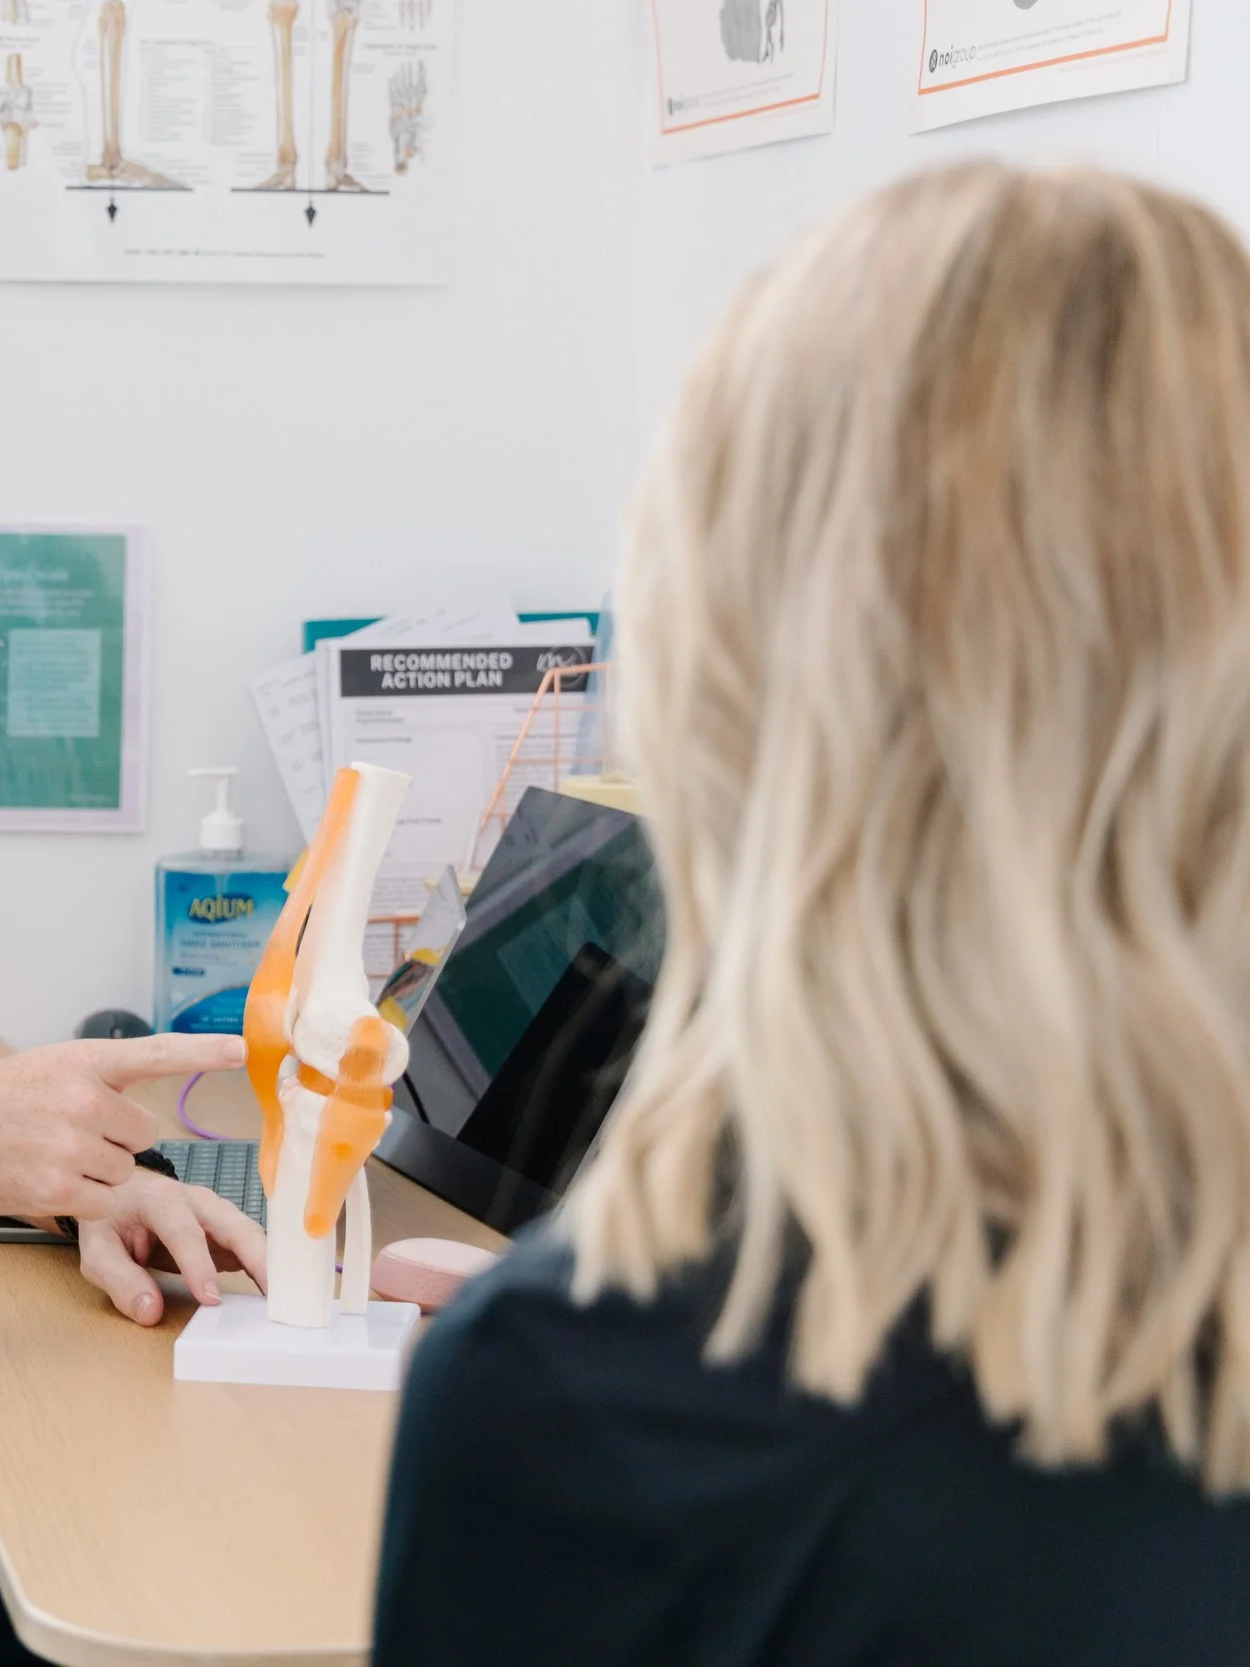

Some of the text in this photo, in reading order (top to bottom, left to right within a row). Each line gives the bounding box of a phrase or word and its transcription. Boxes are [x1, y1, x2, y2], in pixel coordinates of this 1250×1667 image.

[370, 652, 513, 672] RECOMMENDED
[381, 670, 503, 689] ACTION PLAN
